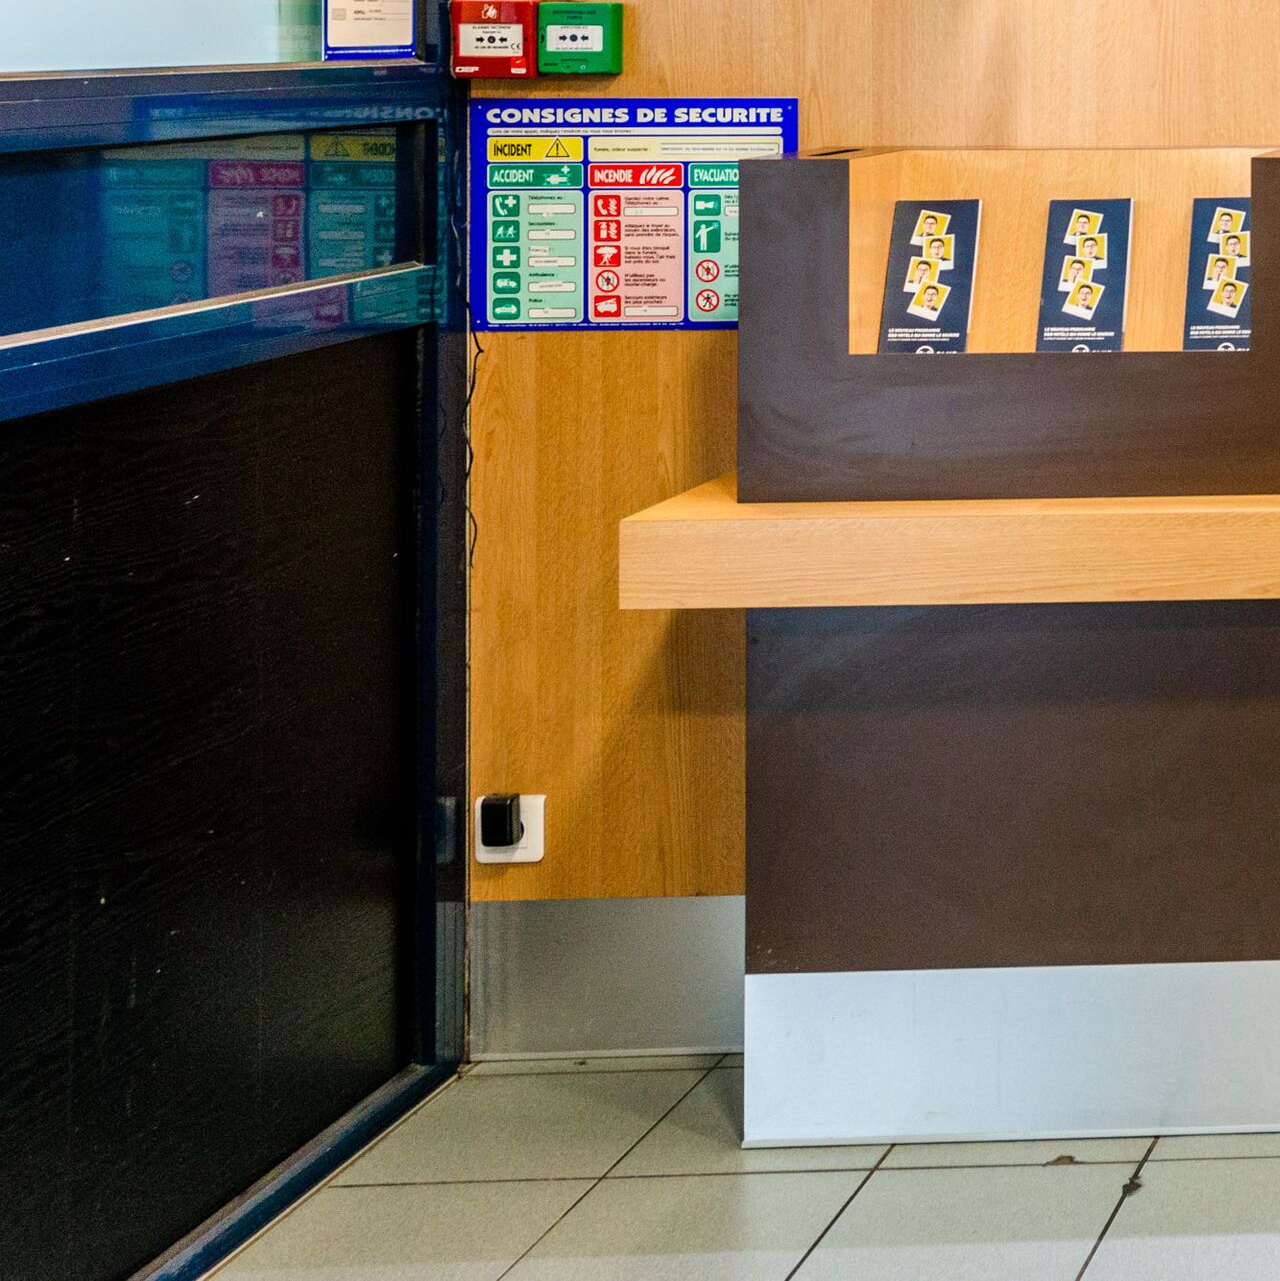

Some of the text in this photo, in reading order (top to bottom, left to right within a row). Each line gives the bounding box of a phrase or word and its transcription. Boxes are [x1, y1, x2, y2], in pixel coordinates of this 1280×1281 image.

[486, 107, 784, 124] CONSIGNES DE SECURITE
[493, 143, 532, 157] INCIDENT
[492, 169, 535, 183] ACCIDENT
[593, 169, 633, 183] INCENDIE
[693, 168, 739, 183] EVACUATIO
